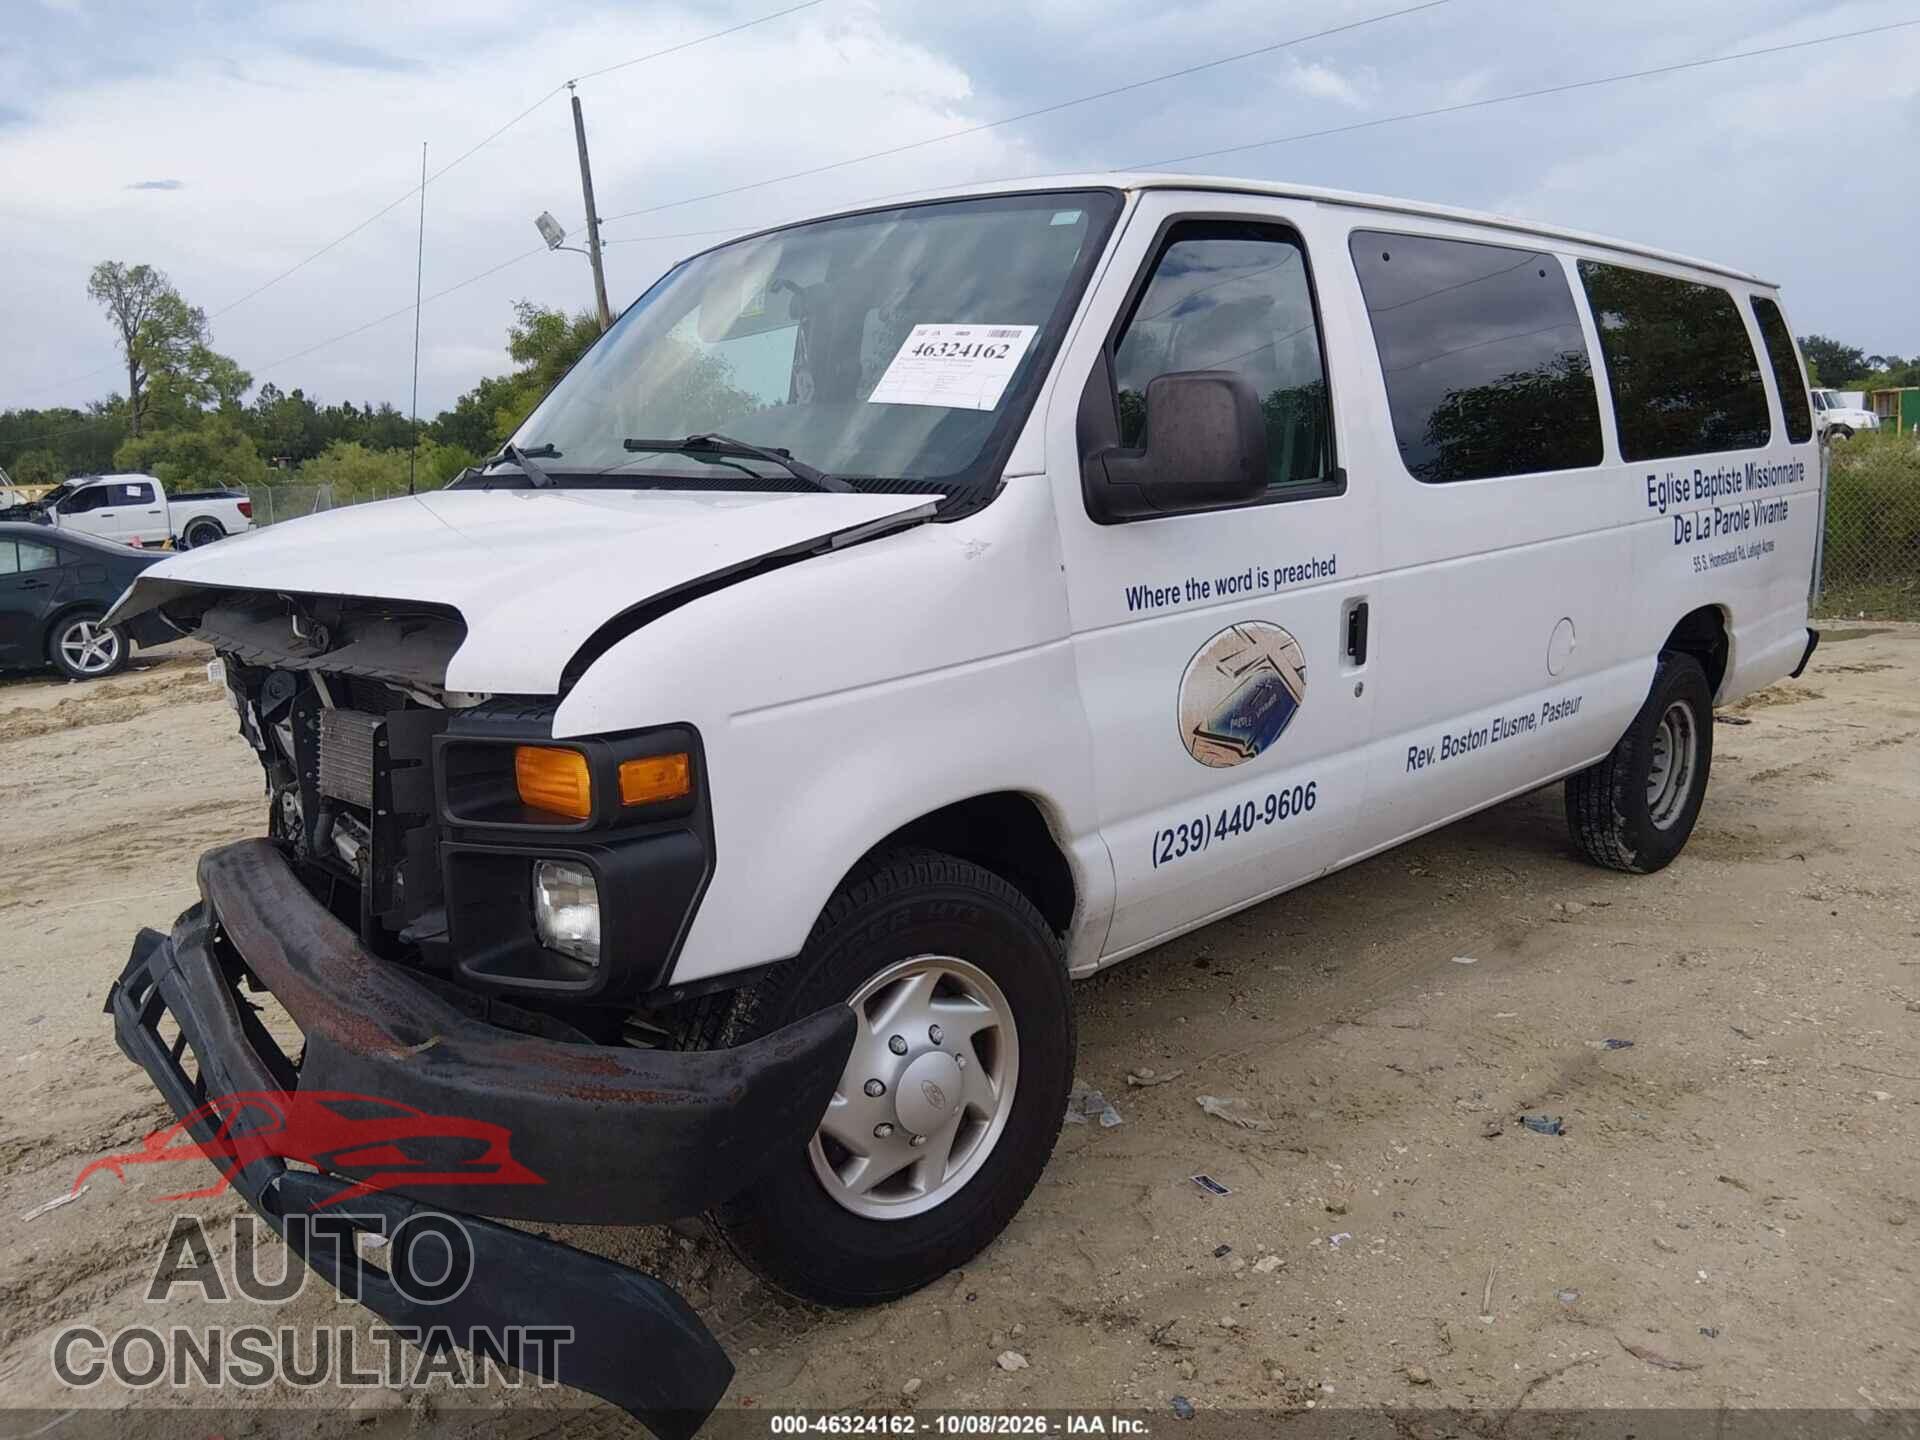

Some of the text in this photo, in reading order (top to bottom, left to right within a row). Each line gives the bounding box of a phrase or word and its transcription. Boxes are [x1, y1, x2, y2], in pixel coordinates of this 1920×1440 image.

[911, 342, 1011, 359] 46324162
[1646, 457, 1805, 514] Eglise Baptiste Missionnaire
[1674, 497, 1789, 545] De La Parole Vivante
[1126, 554, 1337, 611] Where the word is preached
[1406, 696, 1583, 773] Rev. Boston Elusme, Pasteur
